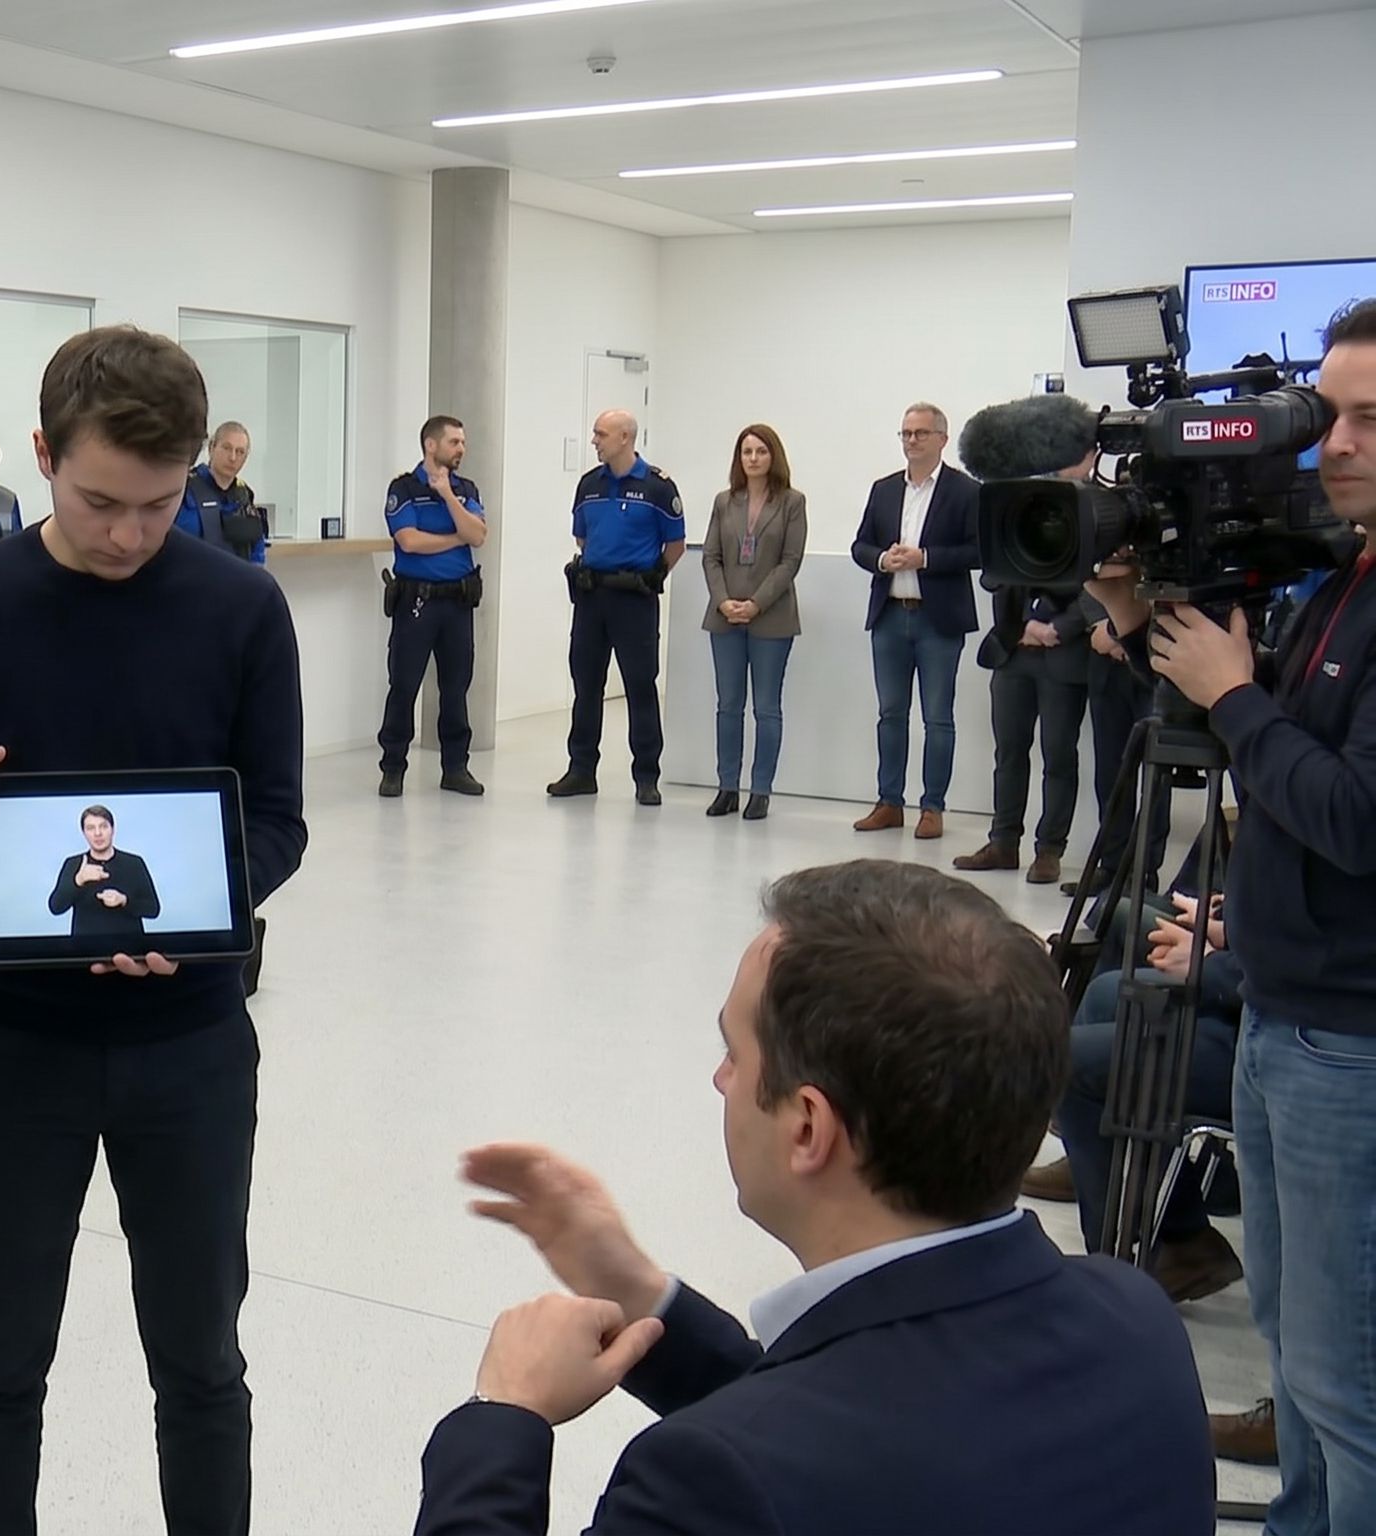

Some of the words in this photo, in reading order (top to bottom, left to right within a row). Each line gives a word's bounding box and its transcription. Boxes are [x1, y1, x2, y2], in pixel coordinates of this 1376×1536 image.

[1206, 286, 1229, 299] RTS
[1232, 283, 1274, 300] INFO
[1186, 425, 1209, 436] RTS
[1214, 422, 1253, 437] INFO
